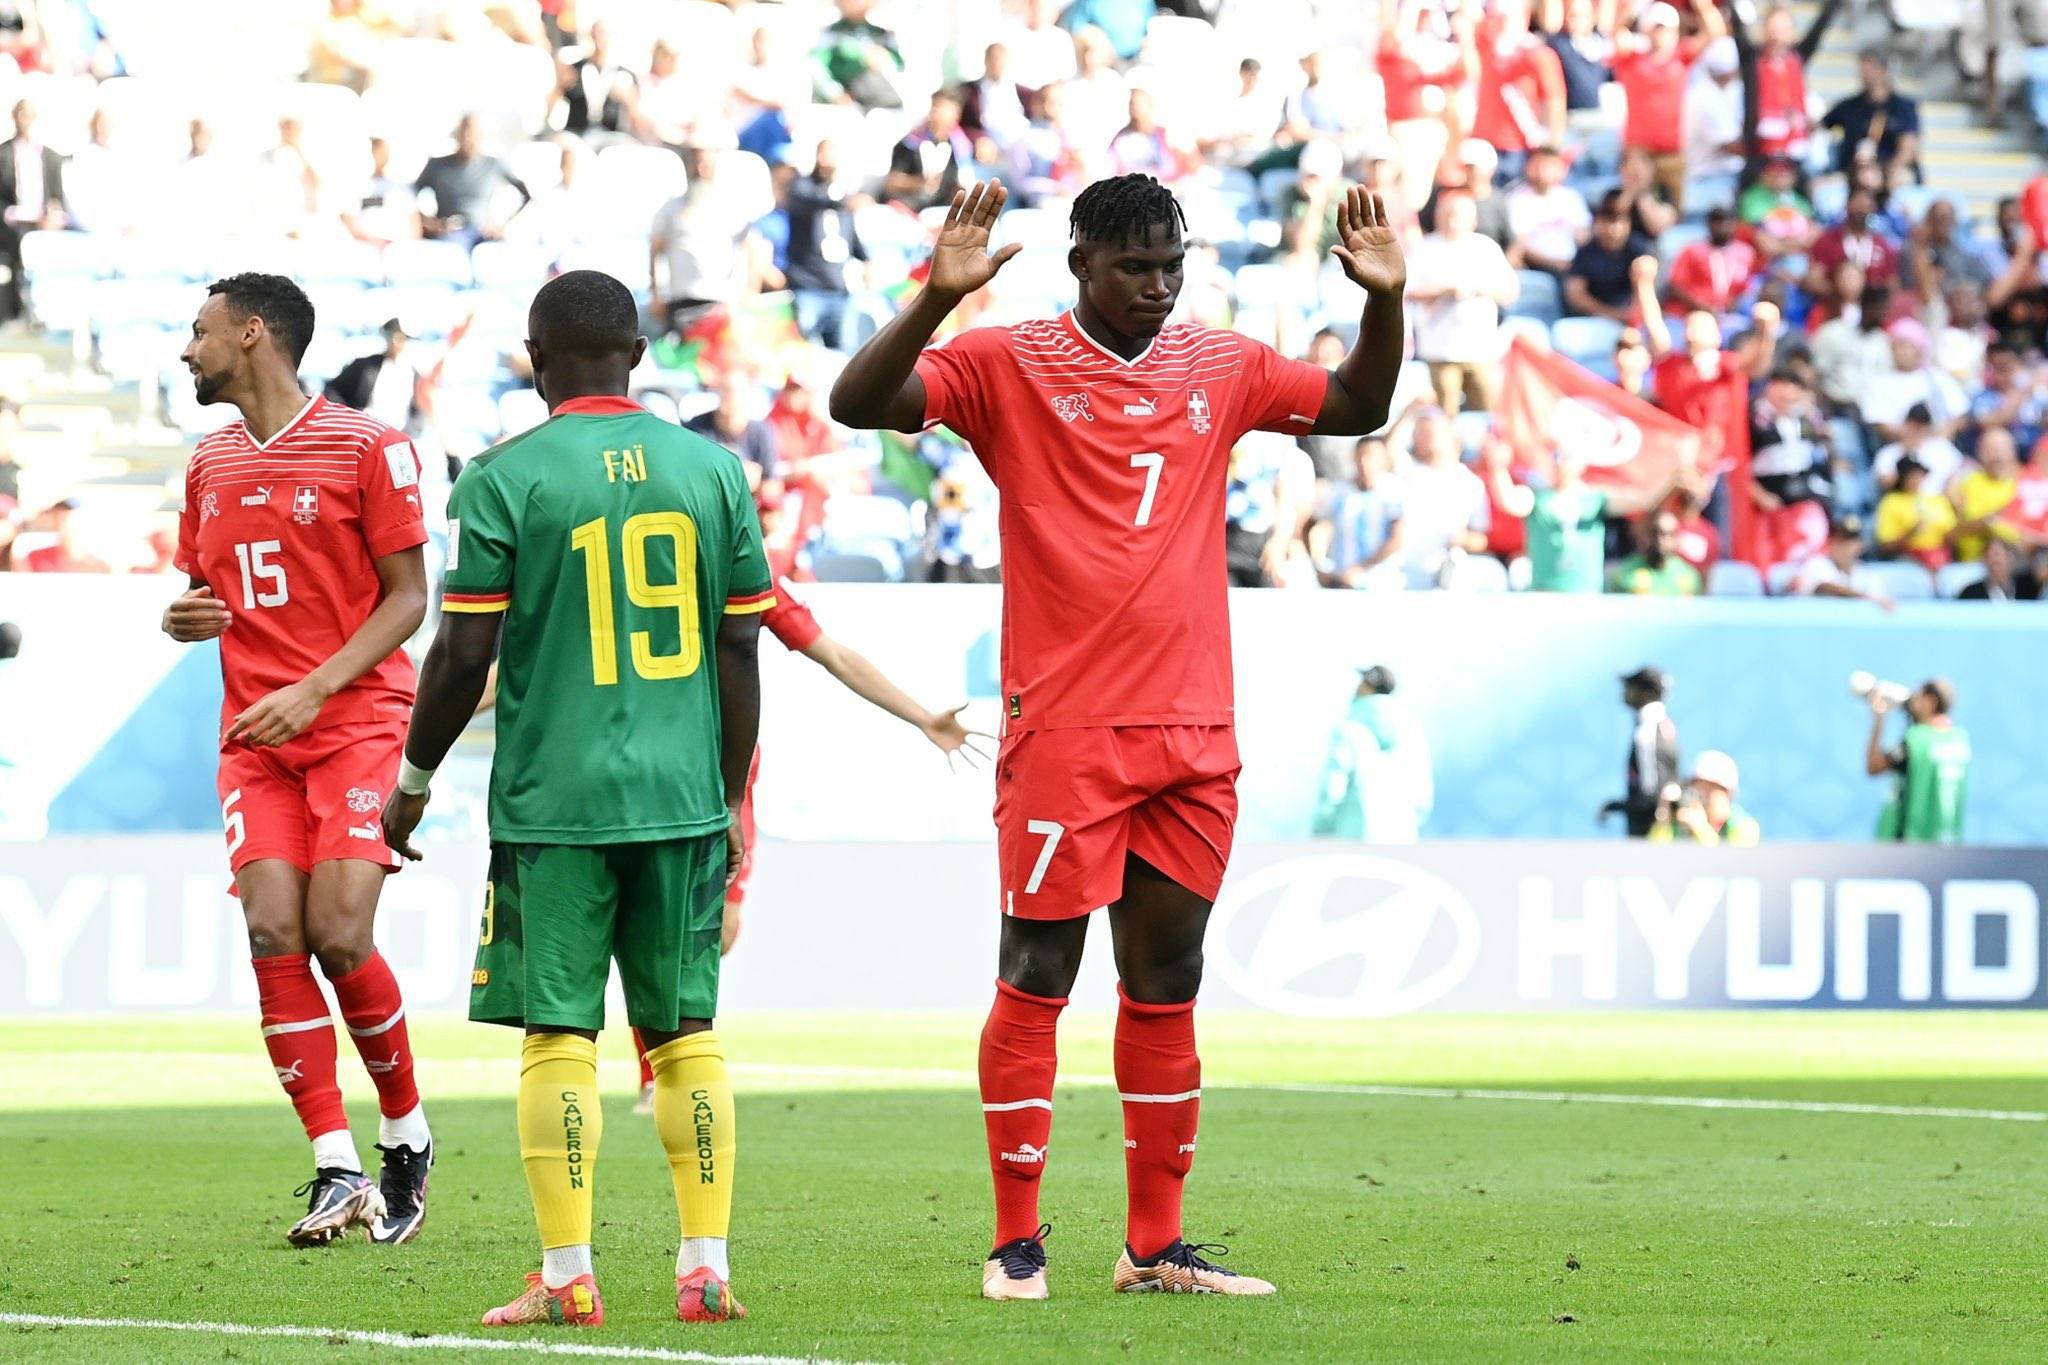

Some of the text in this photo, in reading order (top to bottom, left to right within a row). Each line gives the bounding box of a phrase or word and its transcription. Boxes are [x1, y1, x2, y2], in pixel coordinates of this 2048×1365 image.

[603, 444, 647, 483] FAÏ
[1130, 453, 1165, 526] 7
[234, 540, 289, 610] 15
[571, 511, 701, 686] 19
[1024, 819, 1065, 895] 7
[562, 1091, 584, 1190] CAMEROUN
[692, 1090, 714, 1184] CAMEROUN
[1001, 1152, 1038, 1163] PUMA
